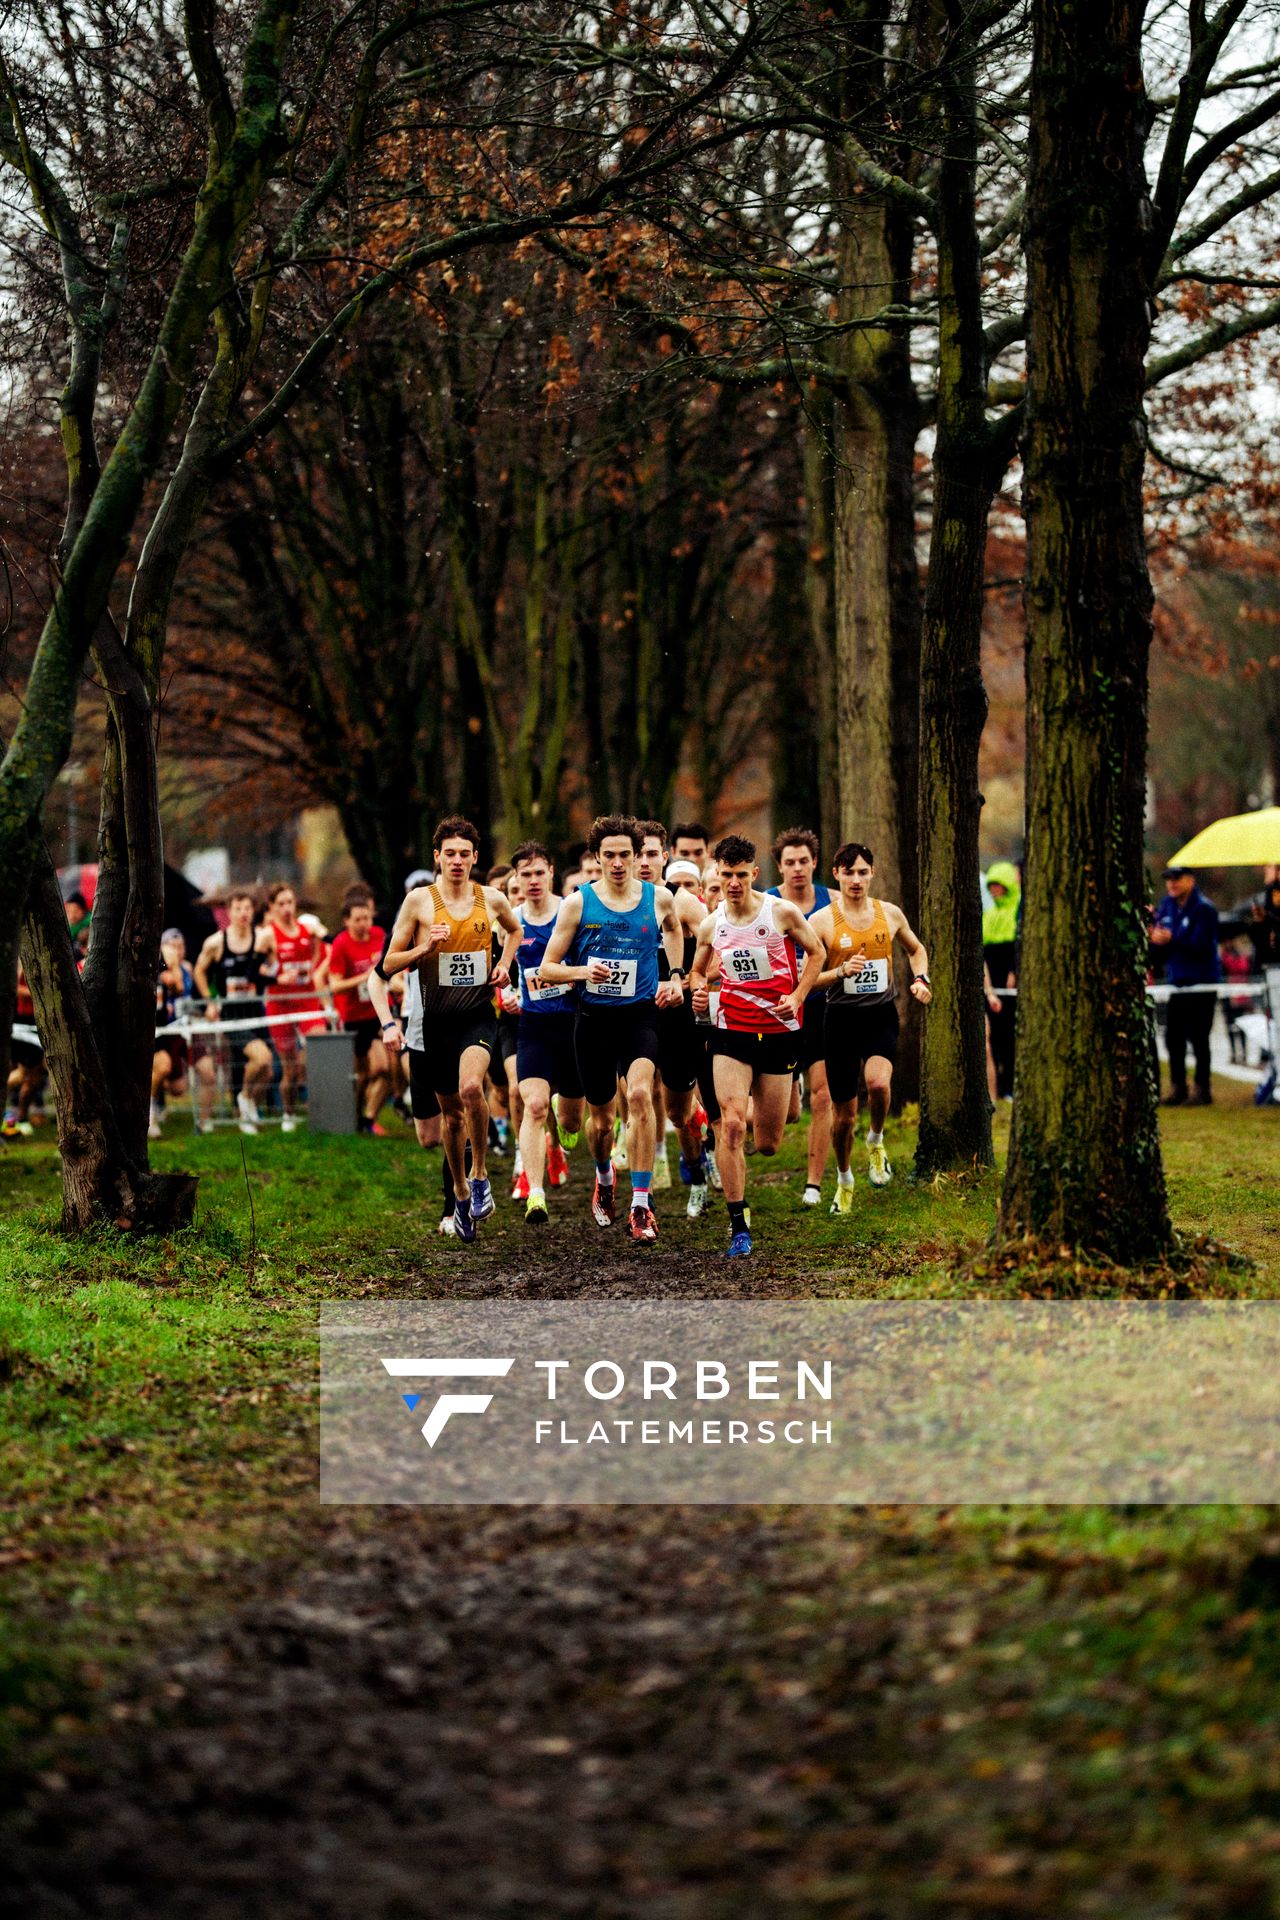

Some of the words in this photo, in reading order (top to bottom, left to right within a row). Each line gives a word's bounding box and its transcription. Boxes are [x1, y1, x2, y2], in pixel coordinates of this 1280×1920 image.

[452, 954, 471, 962] GLS
[733, 950, 750, 958] GLS
[449, 963, 475, 976] 231
[732, 958, 758, 972] 931
[604, 971, 630, 985] 27
[854, 970, 879, 983] 225
